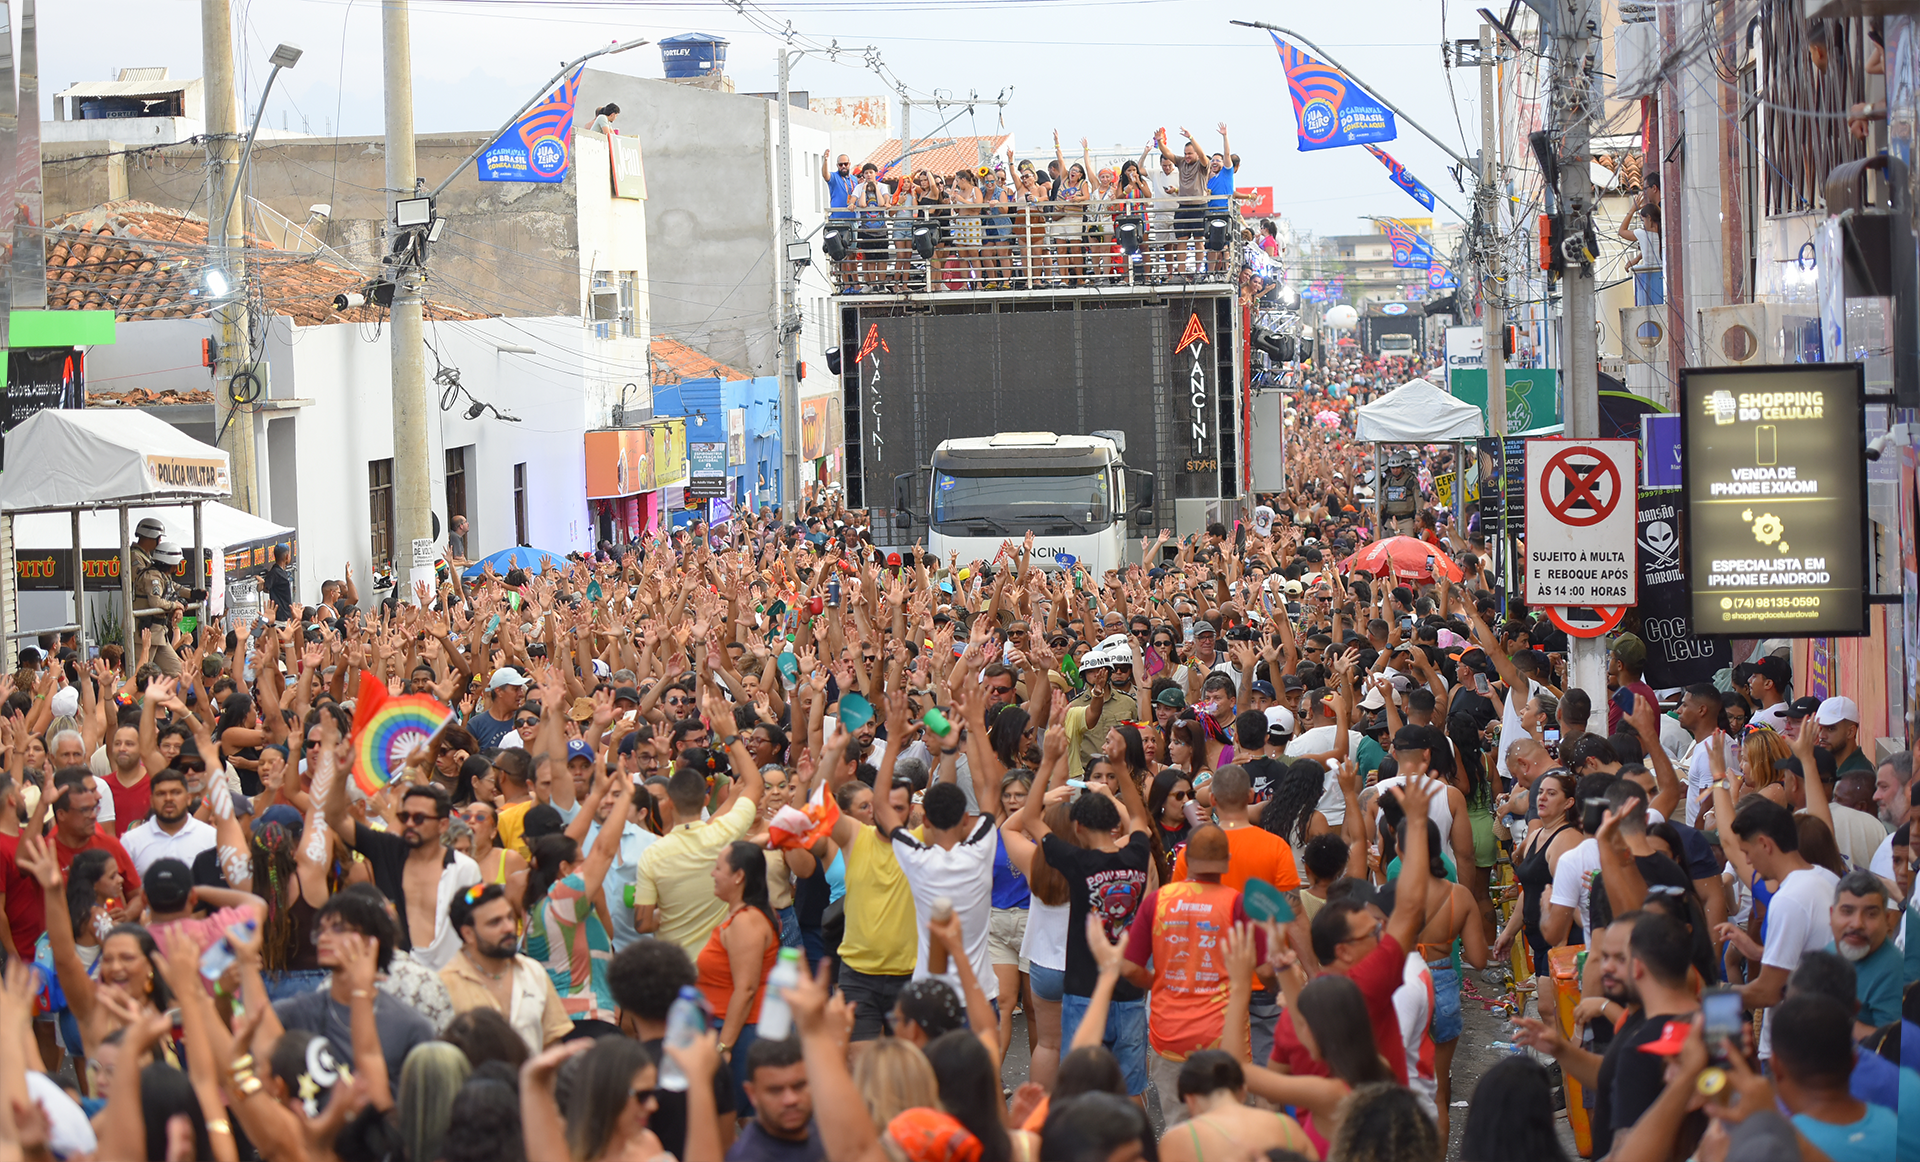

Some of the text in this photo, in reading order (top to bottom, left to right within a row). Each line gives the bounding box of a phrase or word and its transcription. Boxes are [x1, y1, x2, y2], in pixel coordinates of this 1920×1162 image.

[1306, 109, 1323, 122] JUA
[1340, 113, 1385, 127] DO BRASIL
[486, 154, 527, 165] DO BRASIL
[1738, 391, 1824, 408] SHOPPING
[1739, 406, 1824, 421] DO CELULAR
[158, 458, 186, 486] POLÍCIA
[186, 465, 216, 487] MILITAR
[1186, 460, 1217, 472] STAR
[1731, 467, 1797, 480] VENDA DE
[1710, 480, 1818, 495] IPHONE E XIAOMI
[1532, 548, 1625, 563] SUJEITO À MULTA
[1711, 557, 1826, 573] ESPECIALISTA EM
[1534, 567, 1629, 580] E REBOQUE APÓS
[1708, 572, 1831, 586] IPHONE E ANDROID
[1537, 582, 1552, 596] ÀS
[1554, 586, 1567, 596] 14
[1590, 586, 1627, 597] HORAS
[1733, 596, 1821, 609] (74) 98135-0590
[1644, 616, 1687, 643] Coc
